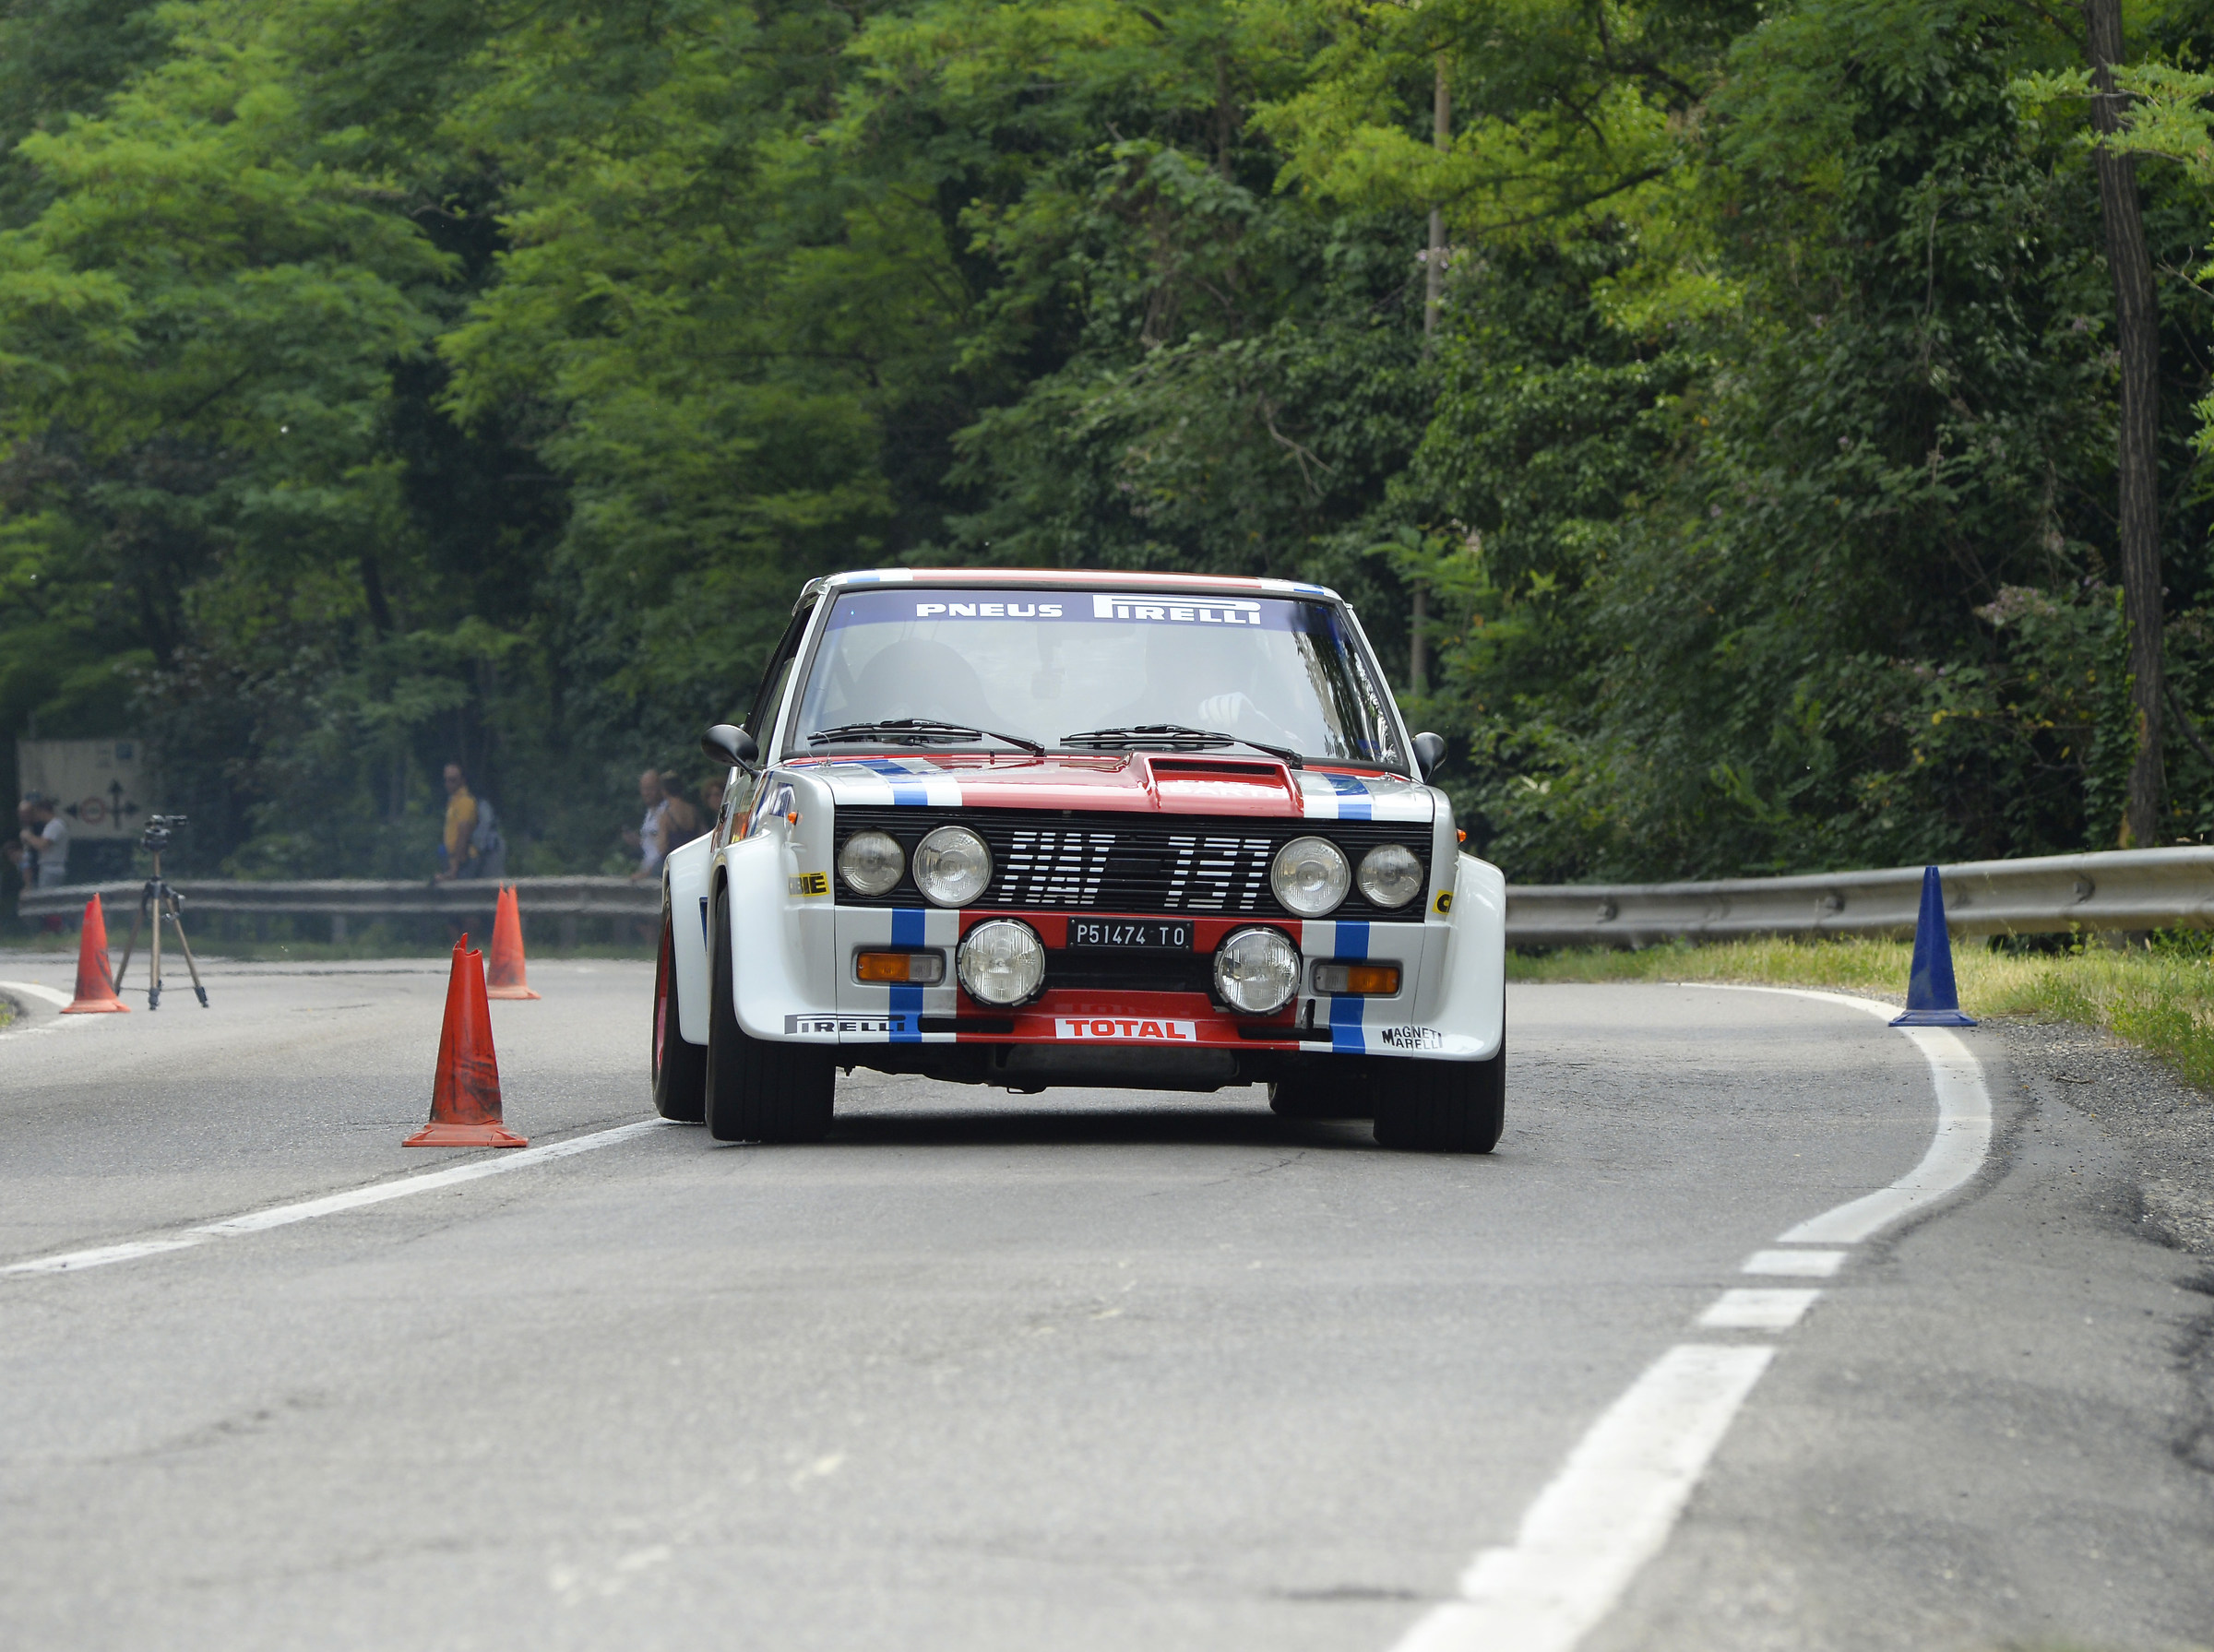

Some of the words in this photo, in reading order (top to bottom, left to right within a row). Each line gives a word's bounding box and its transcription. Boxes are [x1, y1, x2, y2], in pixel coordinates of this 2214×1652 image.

[916, 603, 1063, 617] PNEUS
[1092, 594, 1261, 624] PIRELLI
[997, 832, 1115, 904] FIAT
[1163, 836, 1272, 909] 131
[1077, 924, 1146, 945] P51474
[1159, 927, 1184, 945] TO
[784, 1013, 906, 1034] PIRELLI
[1065, 1019, 1186, 1040] TOTAL
[1382, 1026, 1442, 1043] MAGNETI
